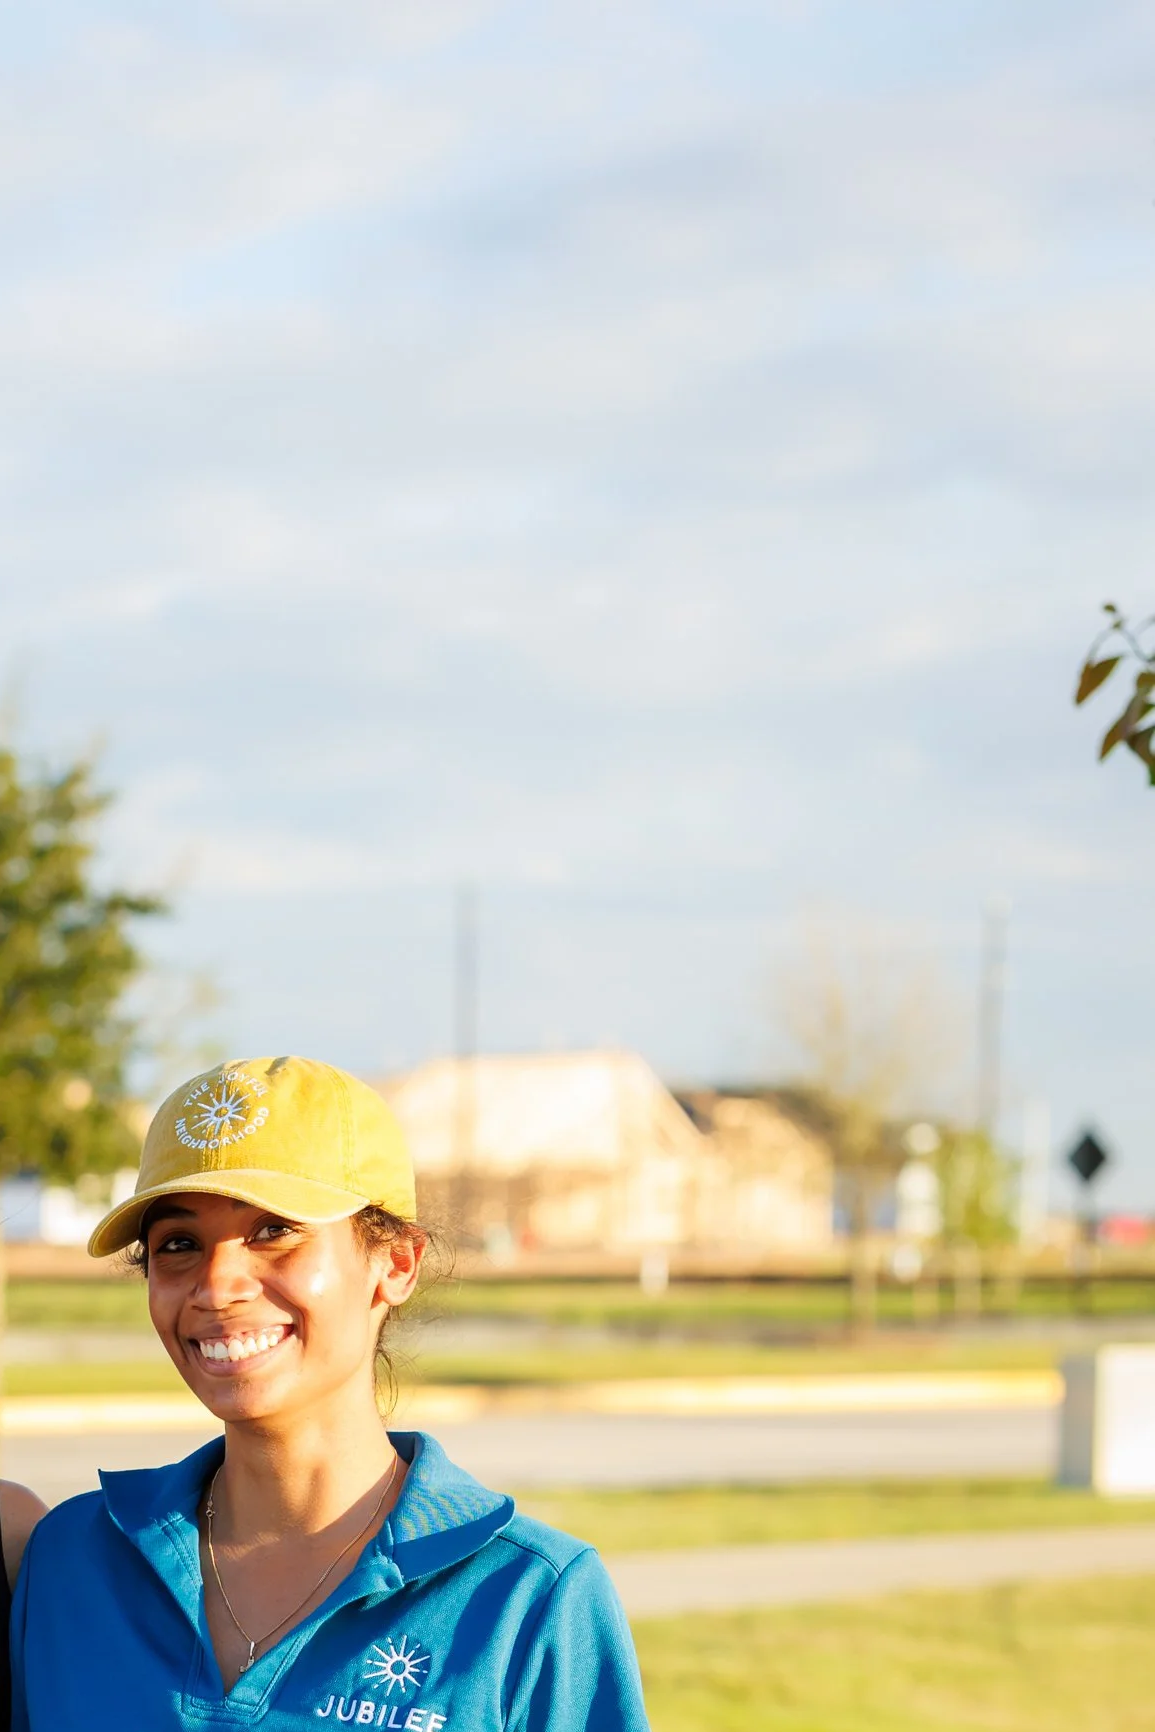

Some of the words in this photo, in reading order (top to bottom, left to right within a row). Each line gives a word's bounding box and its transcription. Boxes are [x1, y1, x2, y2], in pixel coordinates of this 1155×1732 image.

[184, 1080, 210, 1107] THE
[218, 1071, 268, 1098] JOYFUL
[174, 1106, 270, 1149] NEIGHBORHOOD
